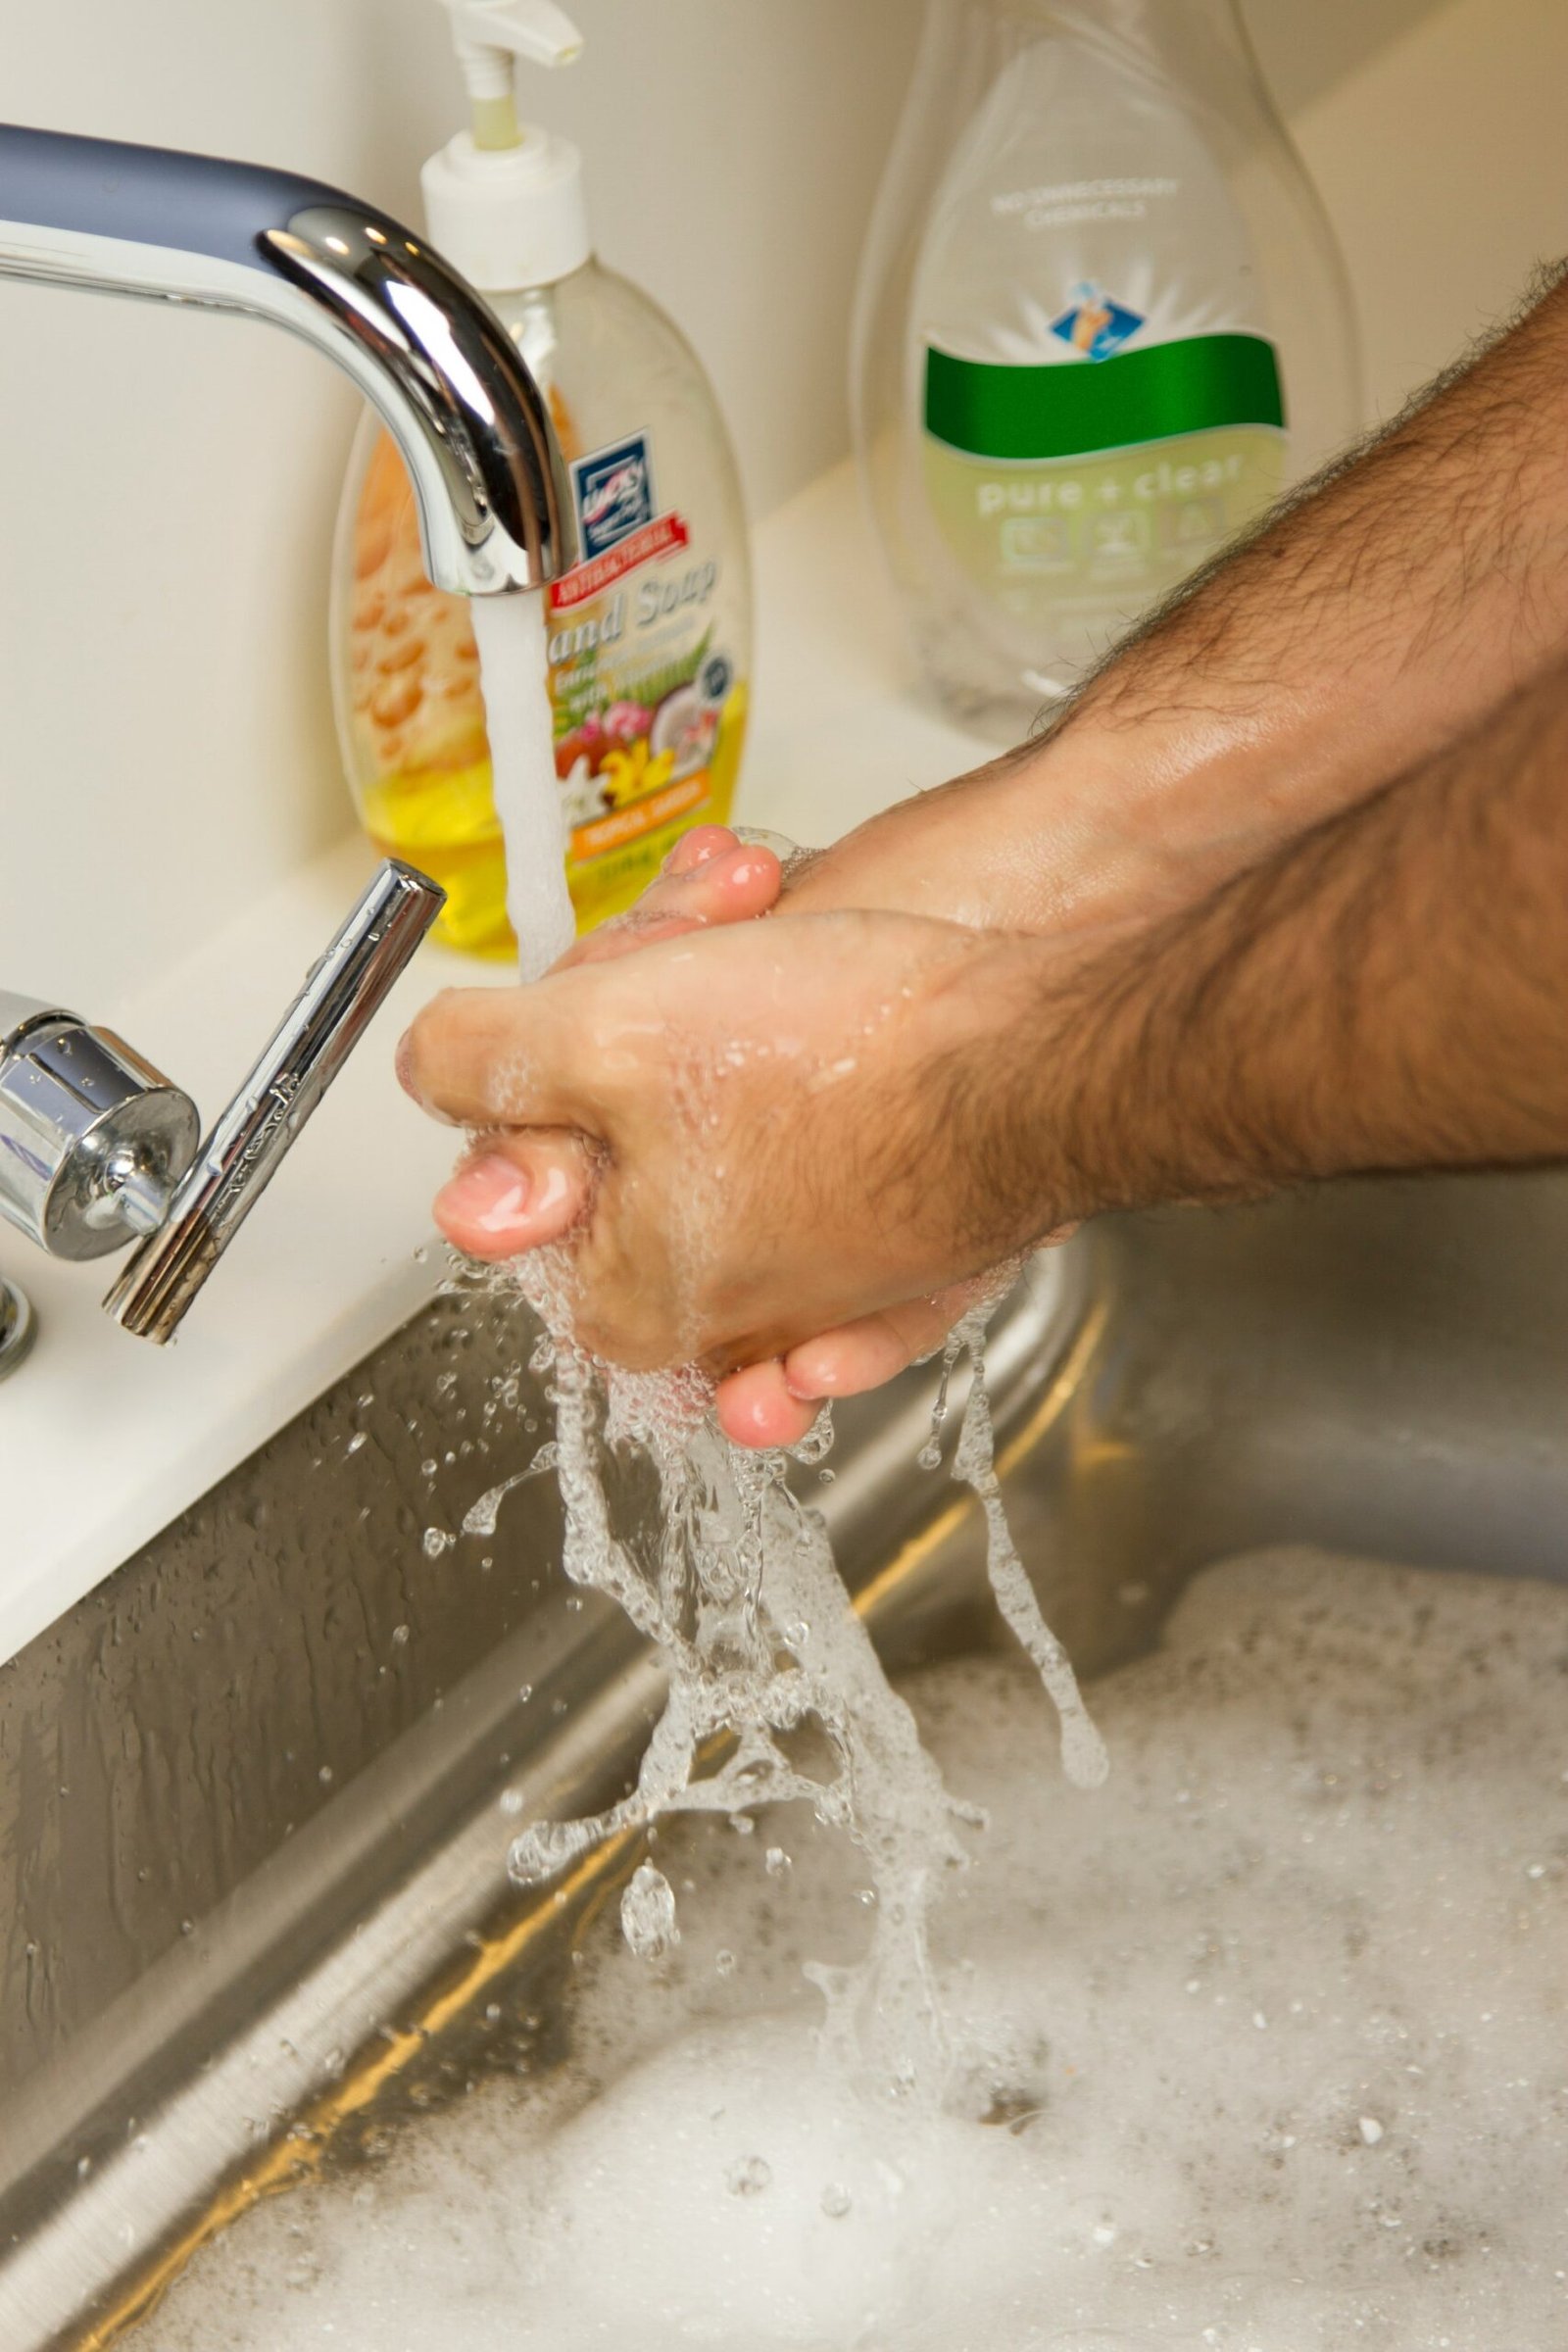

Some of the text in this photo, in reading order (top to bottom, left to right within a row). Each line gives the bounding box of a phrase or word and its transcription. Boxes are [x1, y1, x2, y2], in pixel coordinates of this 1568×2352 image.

[975, 480, 1083, 516] pure
[1133, 454, 1243, 498] clear
[549, 592, 624, 664] and
[637, 559, 715, 627] Soap
